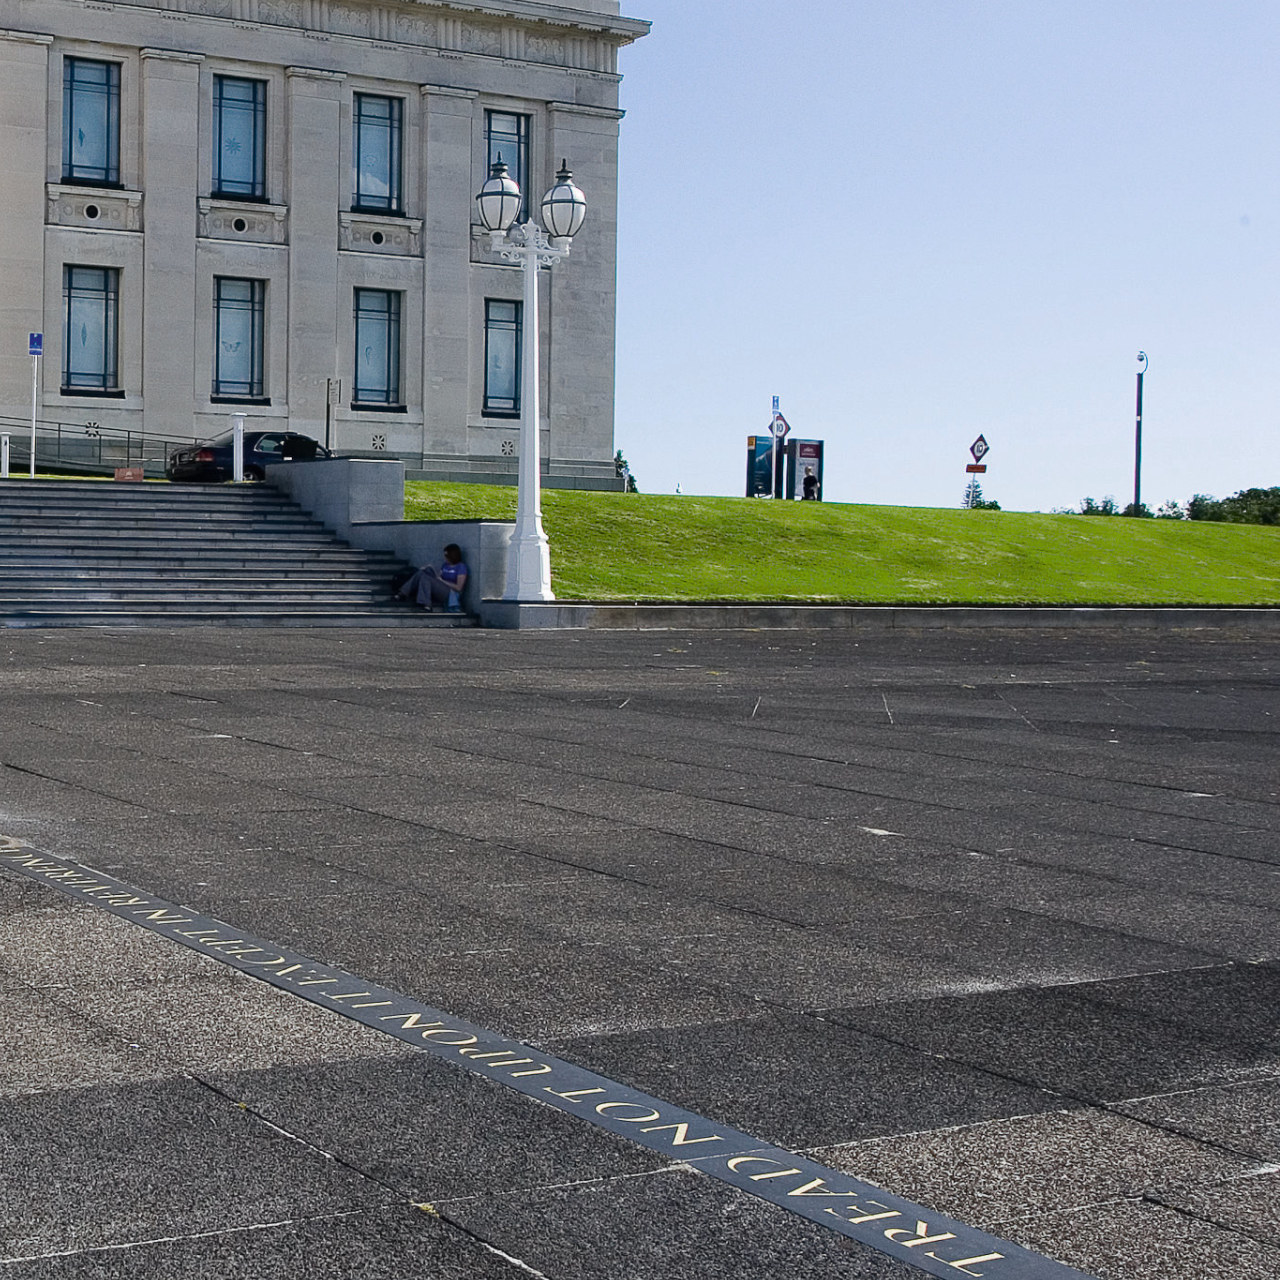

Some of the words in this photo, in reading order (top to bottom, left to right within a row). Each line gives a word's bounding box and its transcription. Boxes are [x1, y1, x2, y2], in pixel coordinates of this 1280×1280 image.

[131, 907, 193, 926] IN
[173, 928, 338, 987] EXCEPT
[320, 991, 392, 1009] IT
[379, 1013, 553, 1078] UPON
[543, 1086, 725, 1148] NOT
[726, 1155, 1005, 1278] TREAD
